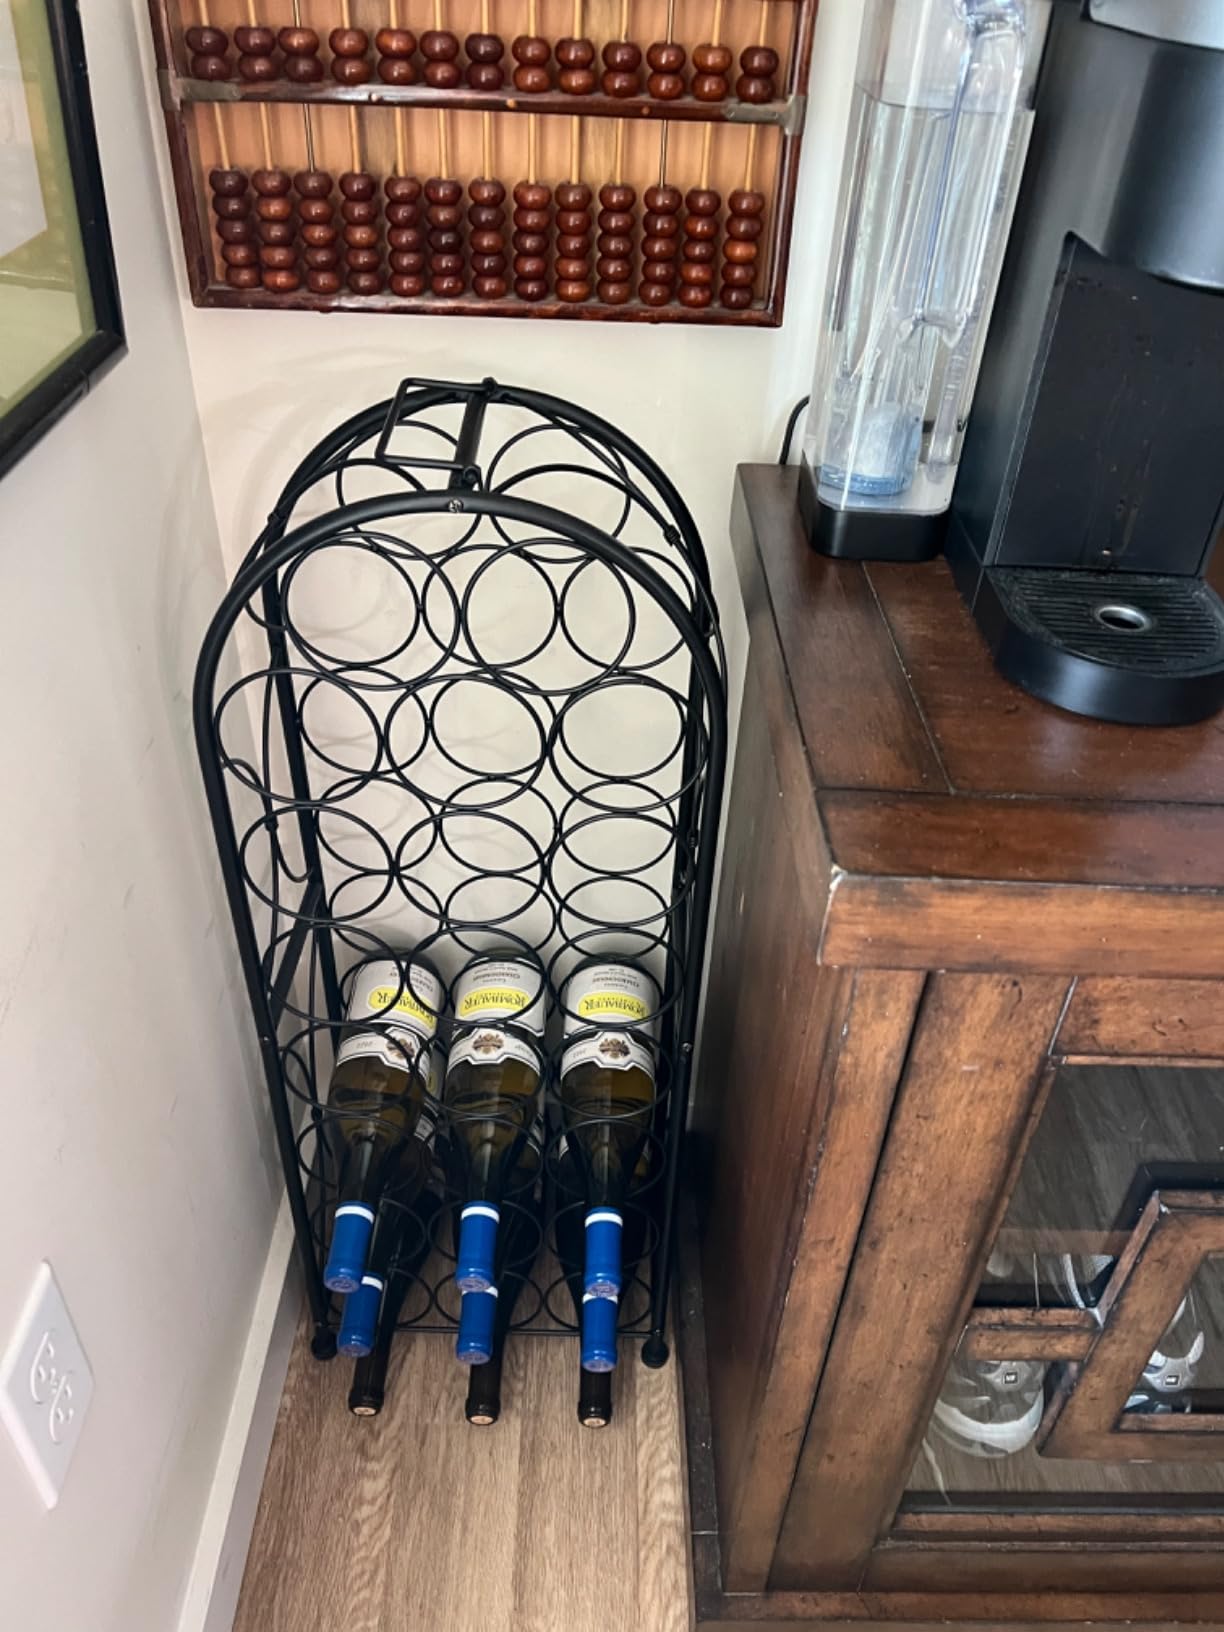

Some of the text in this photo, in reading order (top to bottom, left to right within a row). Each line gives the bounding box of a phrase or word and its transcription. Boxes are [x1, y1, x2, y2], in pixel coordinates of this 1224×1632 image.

[377, 991, 435, 1024] RMBAUR
[463, 993, 526, 1010] ROMBAUER
[584, 999, 646, 1015] ROMBAUER
